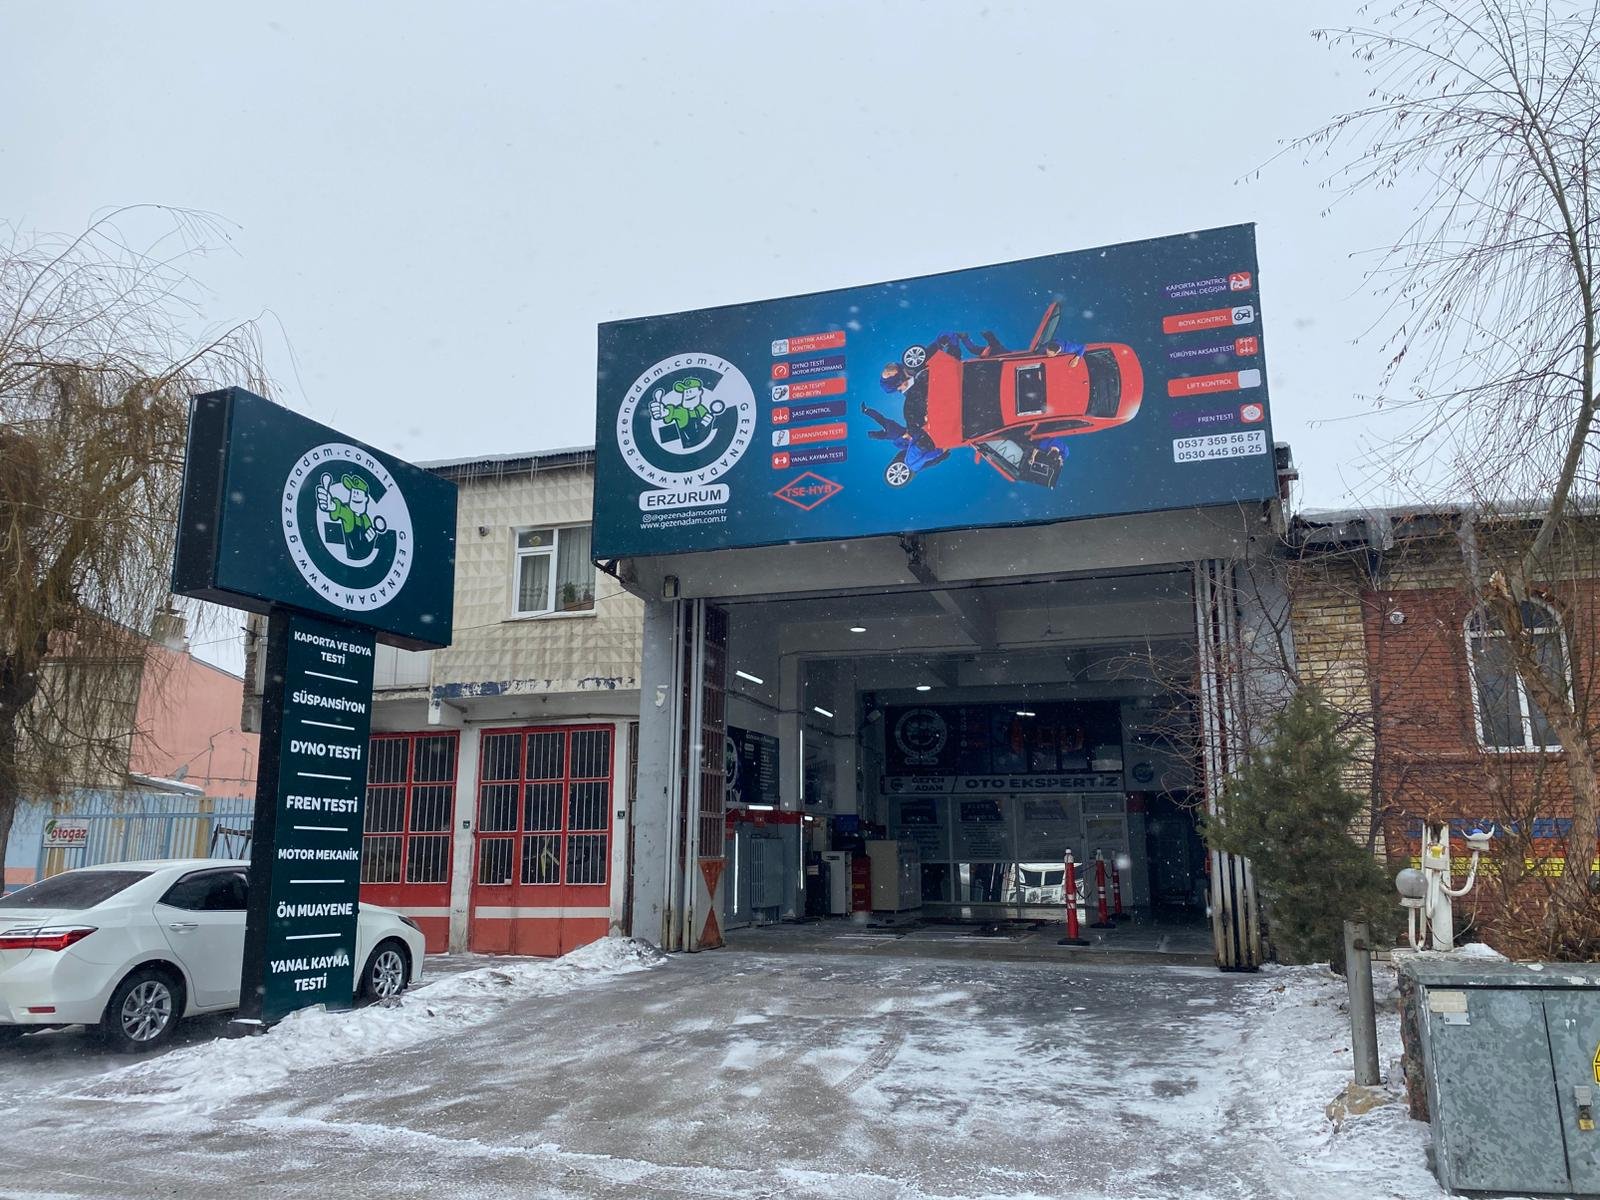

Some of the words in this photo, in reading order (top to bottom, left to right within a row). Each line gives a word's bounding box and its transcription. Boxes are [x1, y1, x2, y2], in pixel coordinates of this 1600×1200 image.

[1166, 282, 1195, 291] KAPORTA
[1197, 278, 1227, 287] KONTROL
[1197, 315, 1227, 324] KONTROL
[792, 344, 815, 352] KONTROL
[1169, 350, 1197, 359] YÜRÜYEN
[1198, 347, 1218, 355] AKSAM
[810, 365, 843, 373] PERFORMANS
[1201, 379, 1232, 387] KONTROL
[806, 407, 831, 416] KONTROL
[683, 402, 749, 485] GEZENADAM
[1177, 439, 1204, 449] 0537
[1208, 436, 1227, 446] 359
[1231, 434, 1244, 443] 56
[1247, 432, 1260, 441] 57
[792, 455, 808, 463] YANAL
[1178, 450, 1205, 460] 0530
[1208, 447, 1228, 457] 445
[1231, 446, 1245, 455] 96
[1248, 444, 1262, 453] 25
[647, 489, 721, 507] ERZURUM
[787, 484, 832, 497] TSE-HYB
[640, 516, 727, 529] www.gezenadam.com.tr
[345, 530, 407, 605] GEZENADAM
[294, 631, 336, 650] KAPORTA
[337, 641, 348, 653] VE
[349, 643, 372, 657] BOYA
[320, 650, 346, 665] TESTİ
[292, 690, 365, 714] SÜSPANSİYON
[290, 740, 327, 757] DYNO
[328, 743, 361, 760] TESTİ
[965, 779, 1004, 788] OTO
[1010, 776, 1118, 788] EKSPERTİZ
[286, 795, 321, 811] FREN
[323, 796, 358, 813] TESTİ
[51, 828, 87, 842] otogaz
[278, 848, 314, 861] MOTOR
[315, 846, 359, 860] MEKANİK
[276, 901, 296, 917] ÖN
[298, 902, 353, 917] MUAYENE
[270, 958, 309, 974] YANAL
[310, 954, 350, 970] KAYMA
[294, 973, 327, 991] TESTİ
